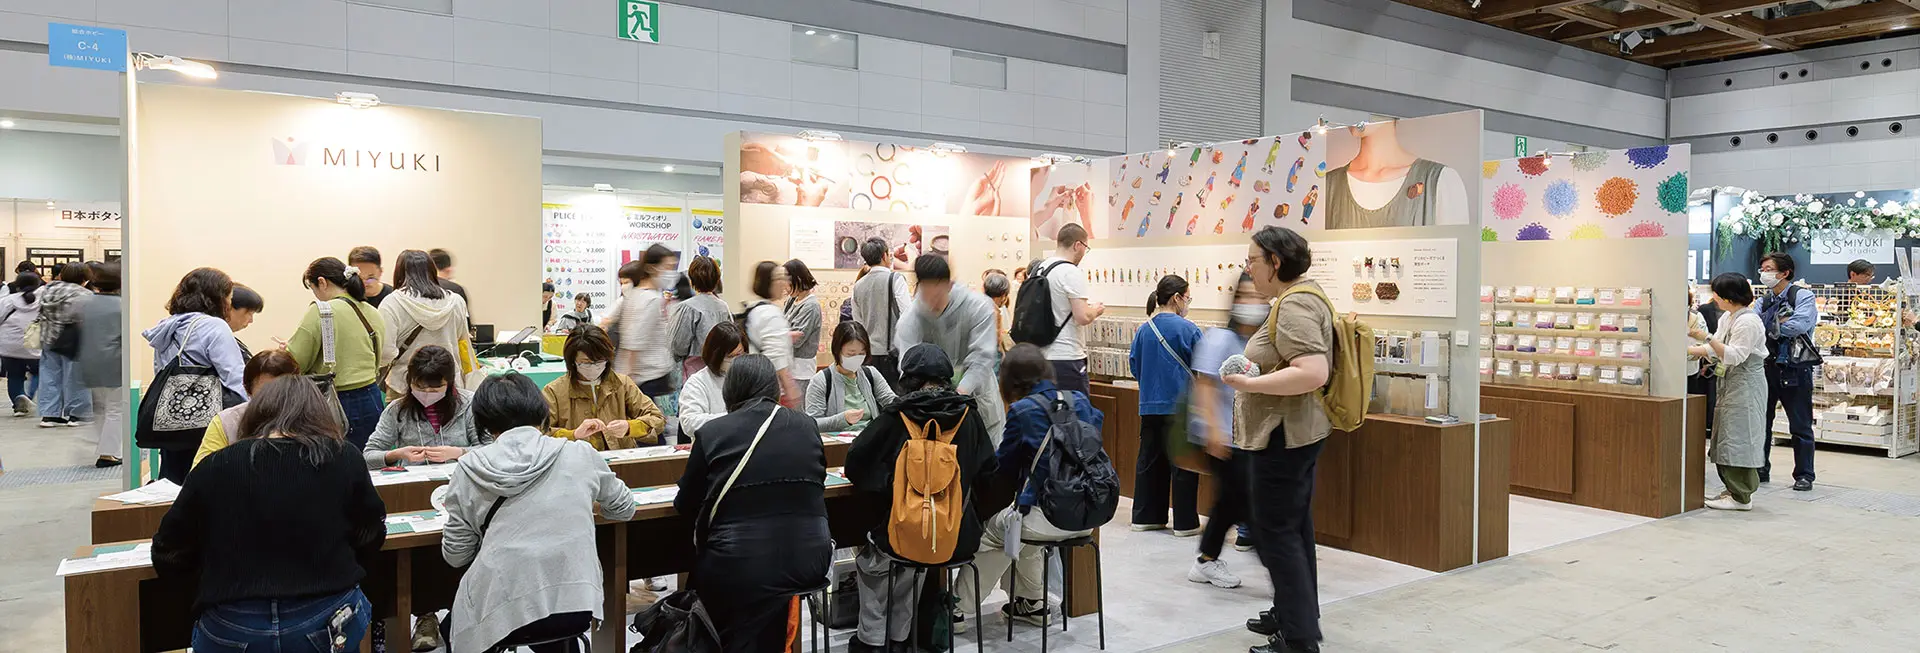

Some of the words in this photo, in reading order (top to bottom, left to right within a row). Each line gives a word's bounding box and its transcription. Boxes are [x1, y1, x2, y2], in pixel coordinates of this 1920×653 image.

[77, 41, 99, 51] C-4
[323, 147, 439, 172] MIYUKI
[61, 210, 121, 221] 日本ボタン
[629, 221, 671, 229] WORKSHOP
[621, 232, 680, 241] WRISTWATCH
[1844, 238, 1882, 247] MIYUKI
